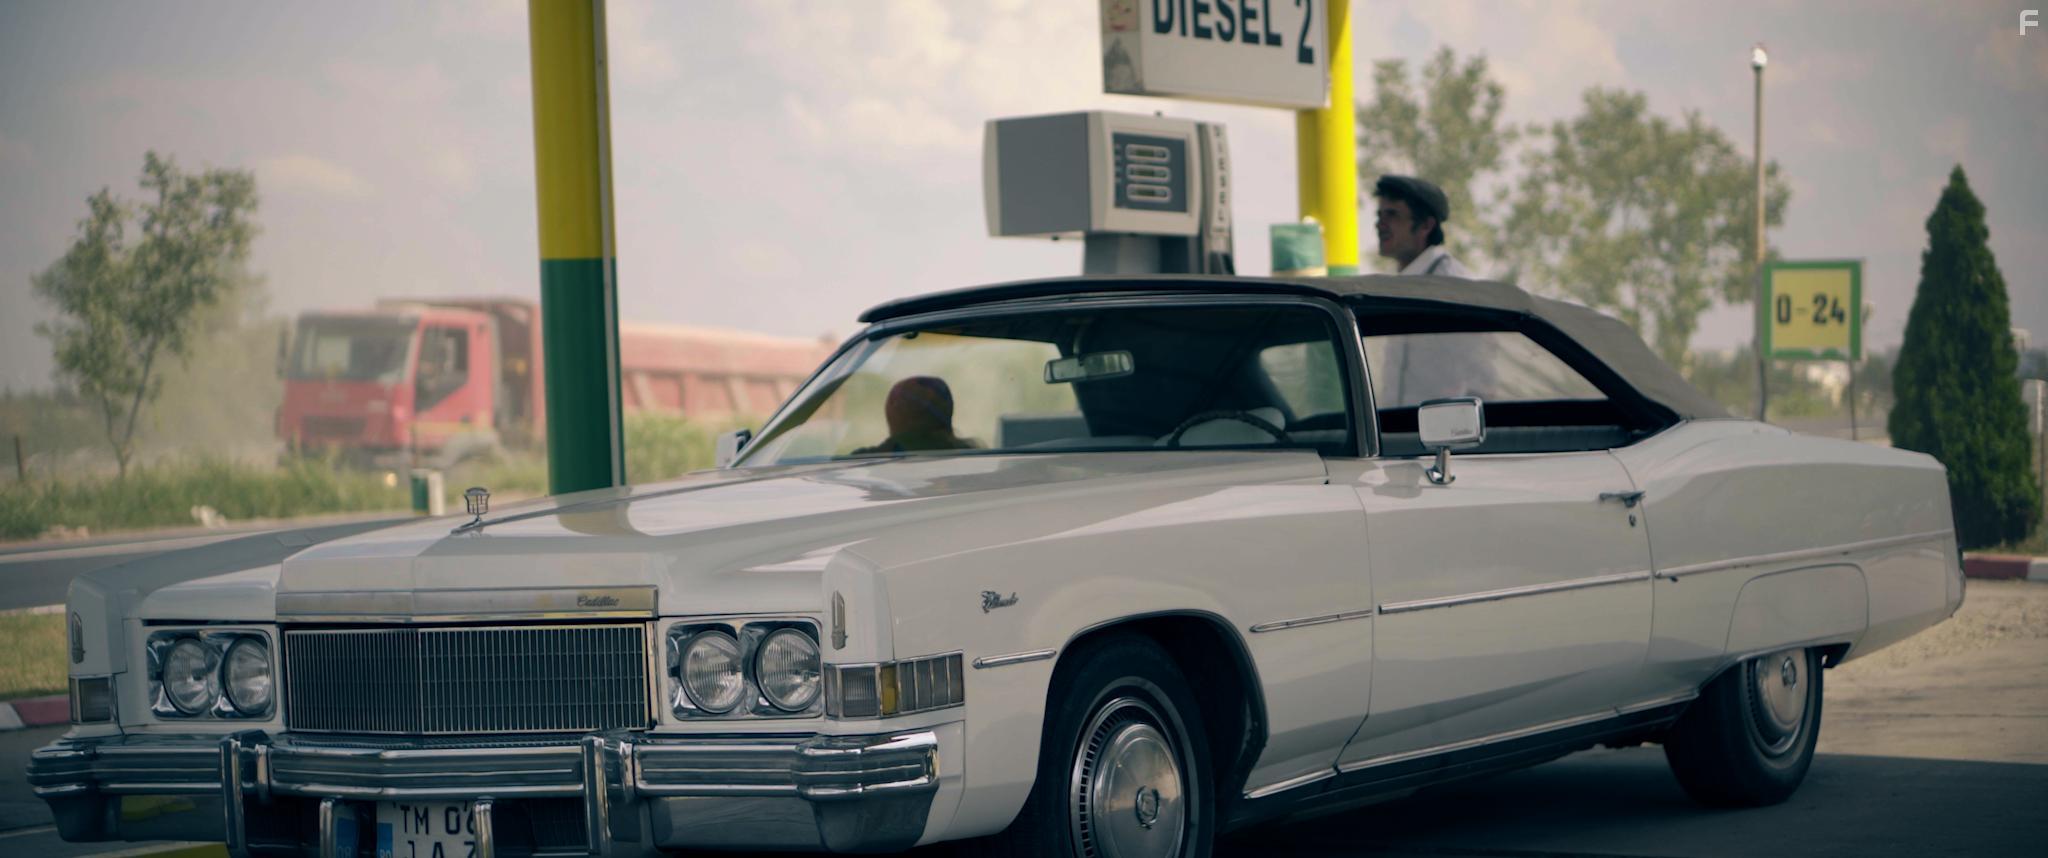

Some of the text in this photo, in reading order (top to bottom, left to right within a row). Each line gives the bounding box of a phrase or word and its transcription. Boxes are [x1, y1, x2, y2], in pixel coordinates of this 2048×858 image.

[1152, 0, 1314, 64] DIESEL 2
[400, 805, 429, 834] TM
